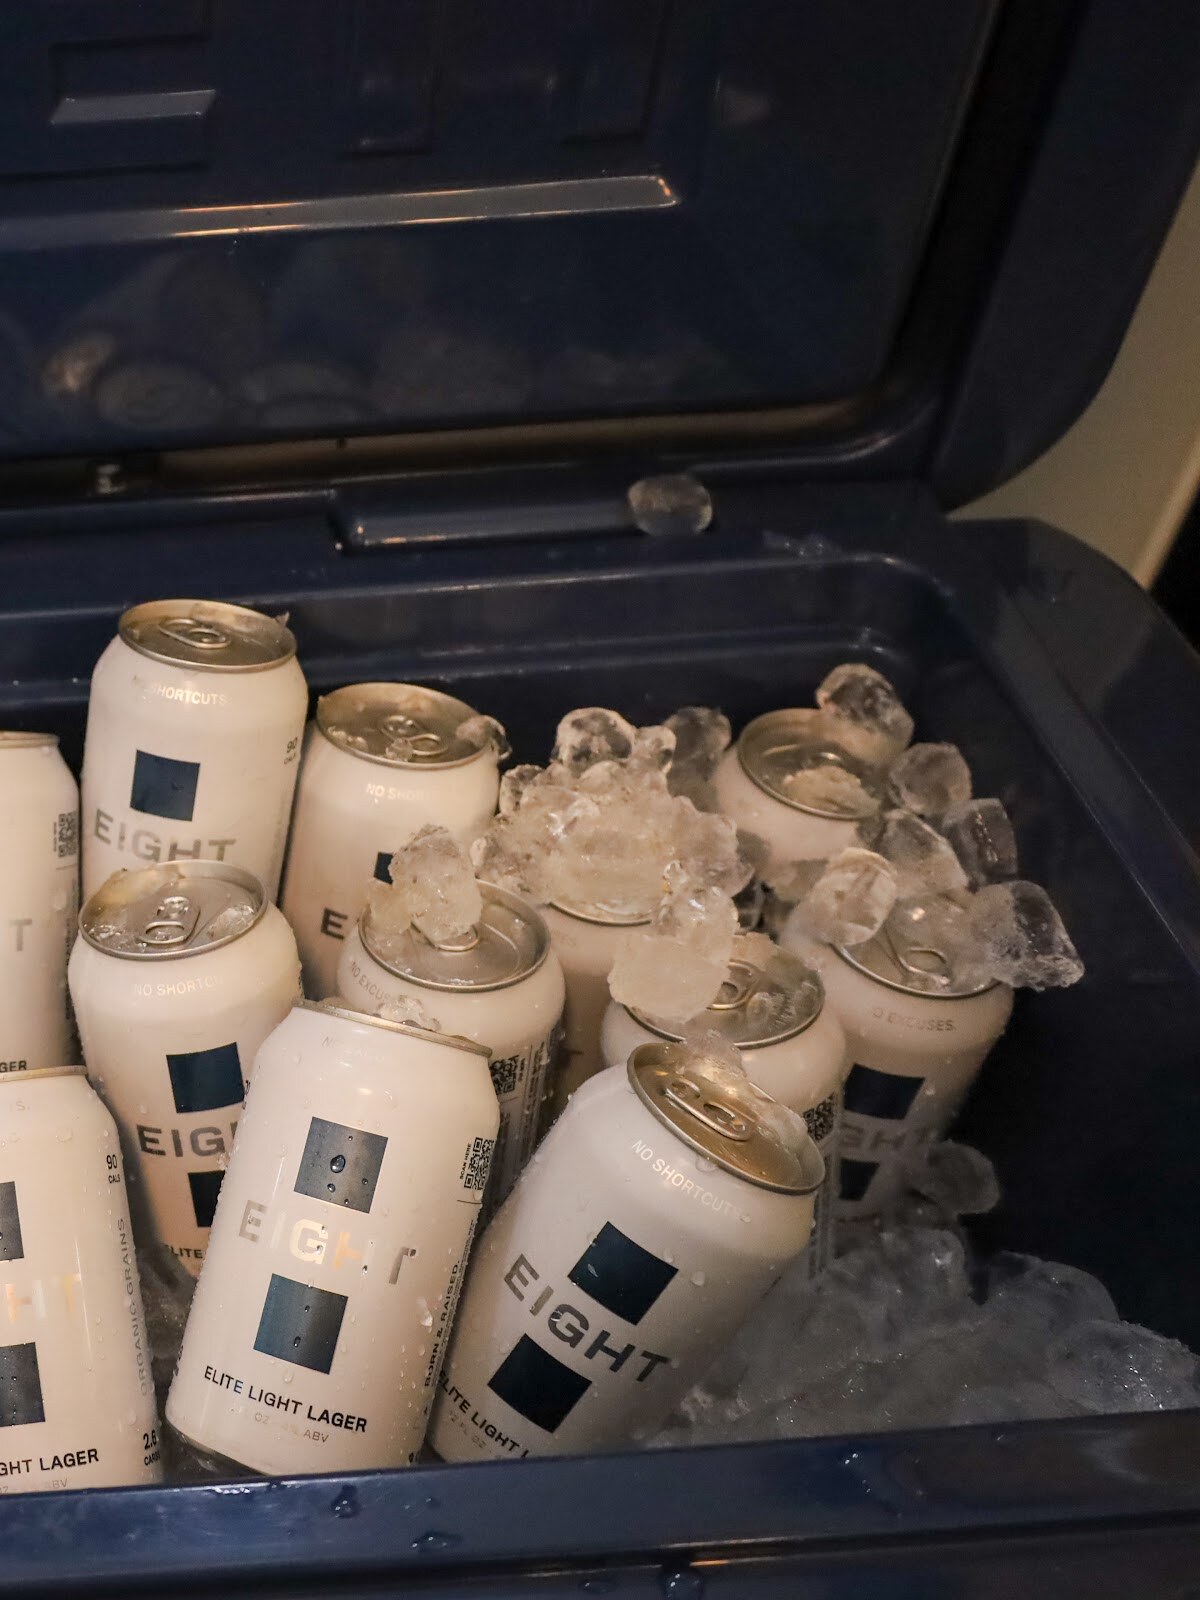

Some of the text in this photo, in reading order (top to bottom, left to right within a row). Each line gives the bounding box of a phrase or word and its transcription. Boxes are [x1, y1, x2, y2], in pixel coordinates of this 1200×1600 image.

[93, 808, 238, 863] EIGHT
[157, 976, 224, 996] SHORTCU
[359, 974, 392, 1001] EXCUS
[136, 1121, 238, 1158] EIG
[631, 1138, 653, 1162] NO
[106, 1154, 118, 1171] 90
[116, 1218, 149, 1398] ORGANIC GRAINS
[503, 1253, 671, 1383] EIGHT
[424, 1343, 440, 1387] BORN
[204, 1365, 244, 1395] ELITE
[248, 1385, 303, 1415] LIGHT
[306, 1404, 369, 1433] LAGER
[143, 1429, 158, 1450] 2.6
[302, 1428, 330, 1444] ABV
[471, 1411, 521, 1452] LIGHT
[39, 1448, 100, 1472] LAGER
